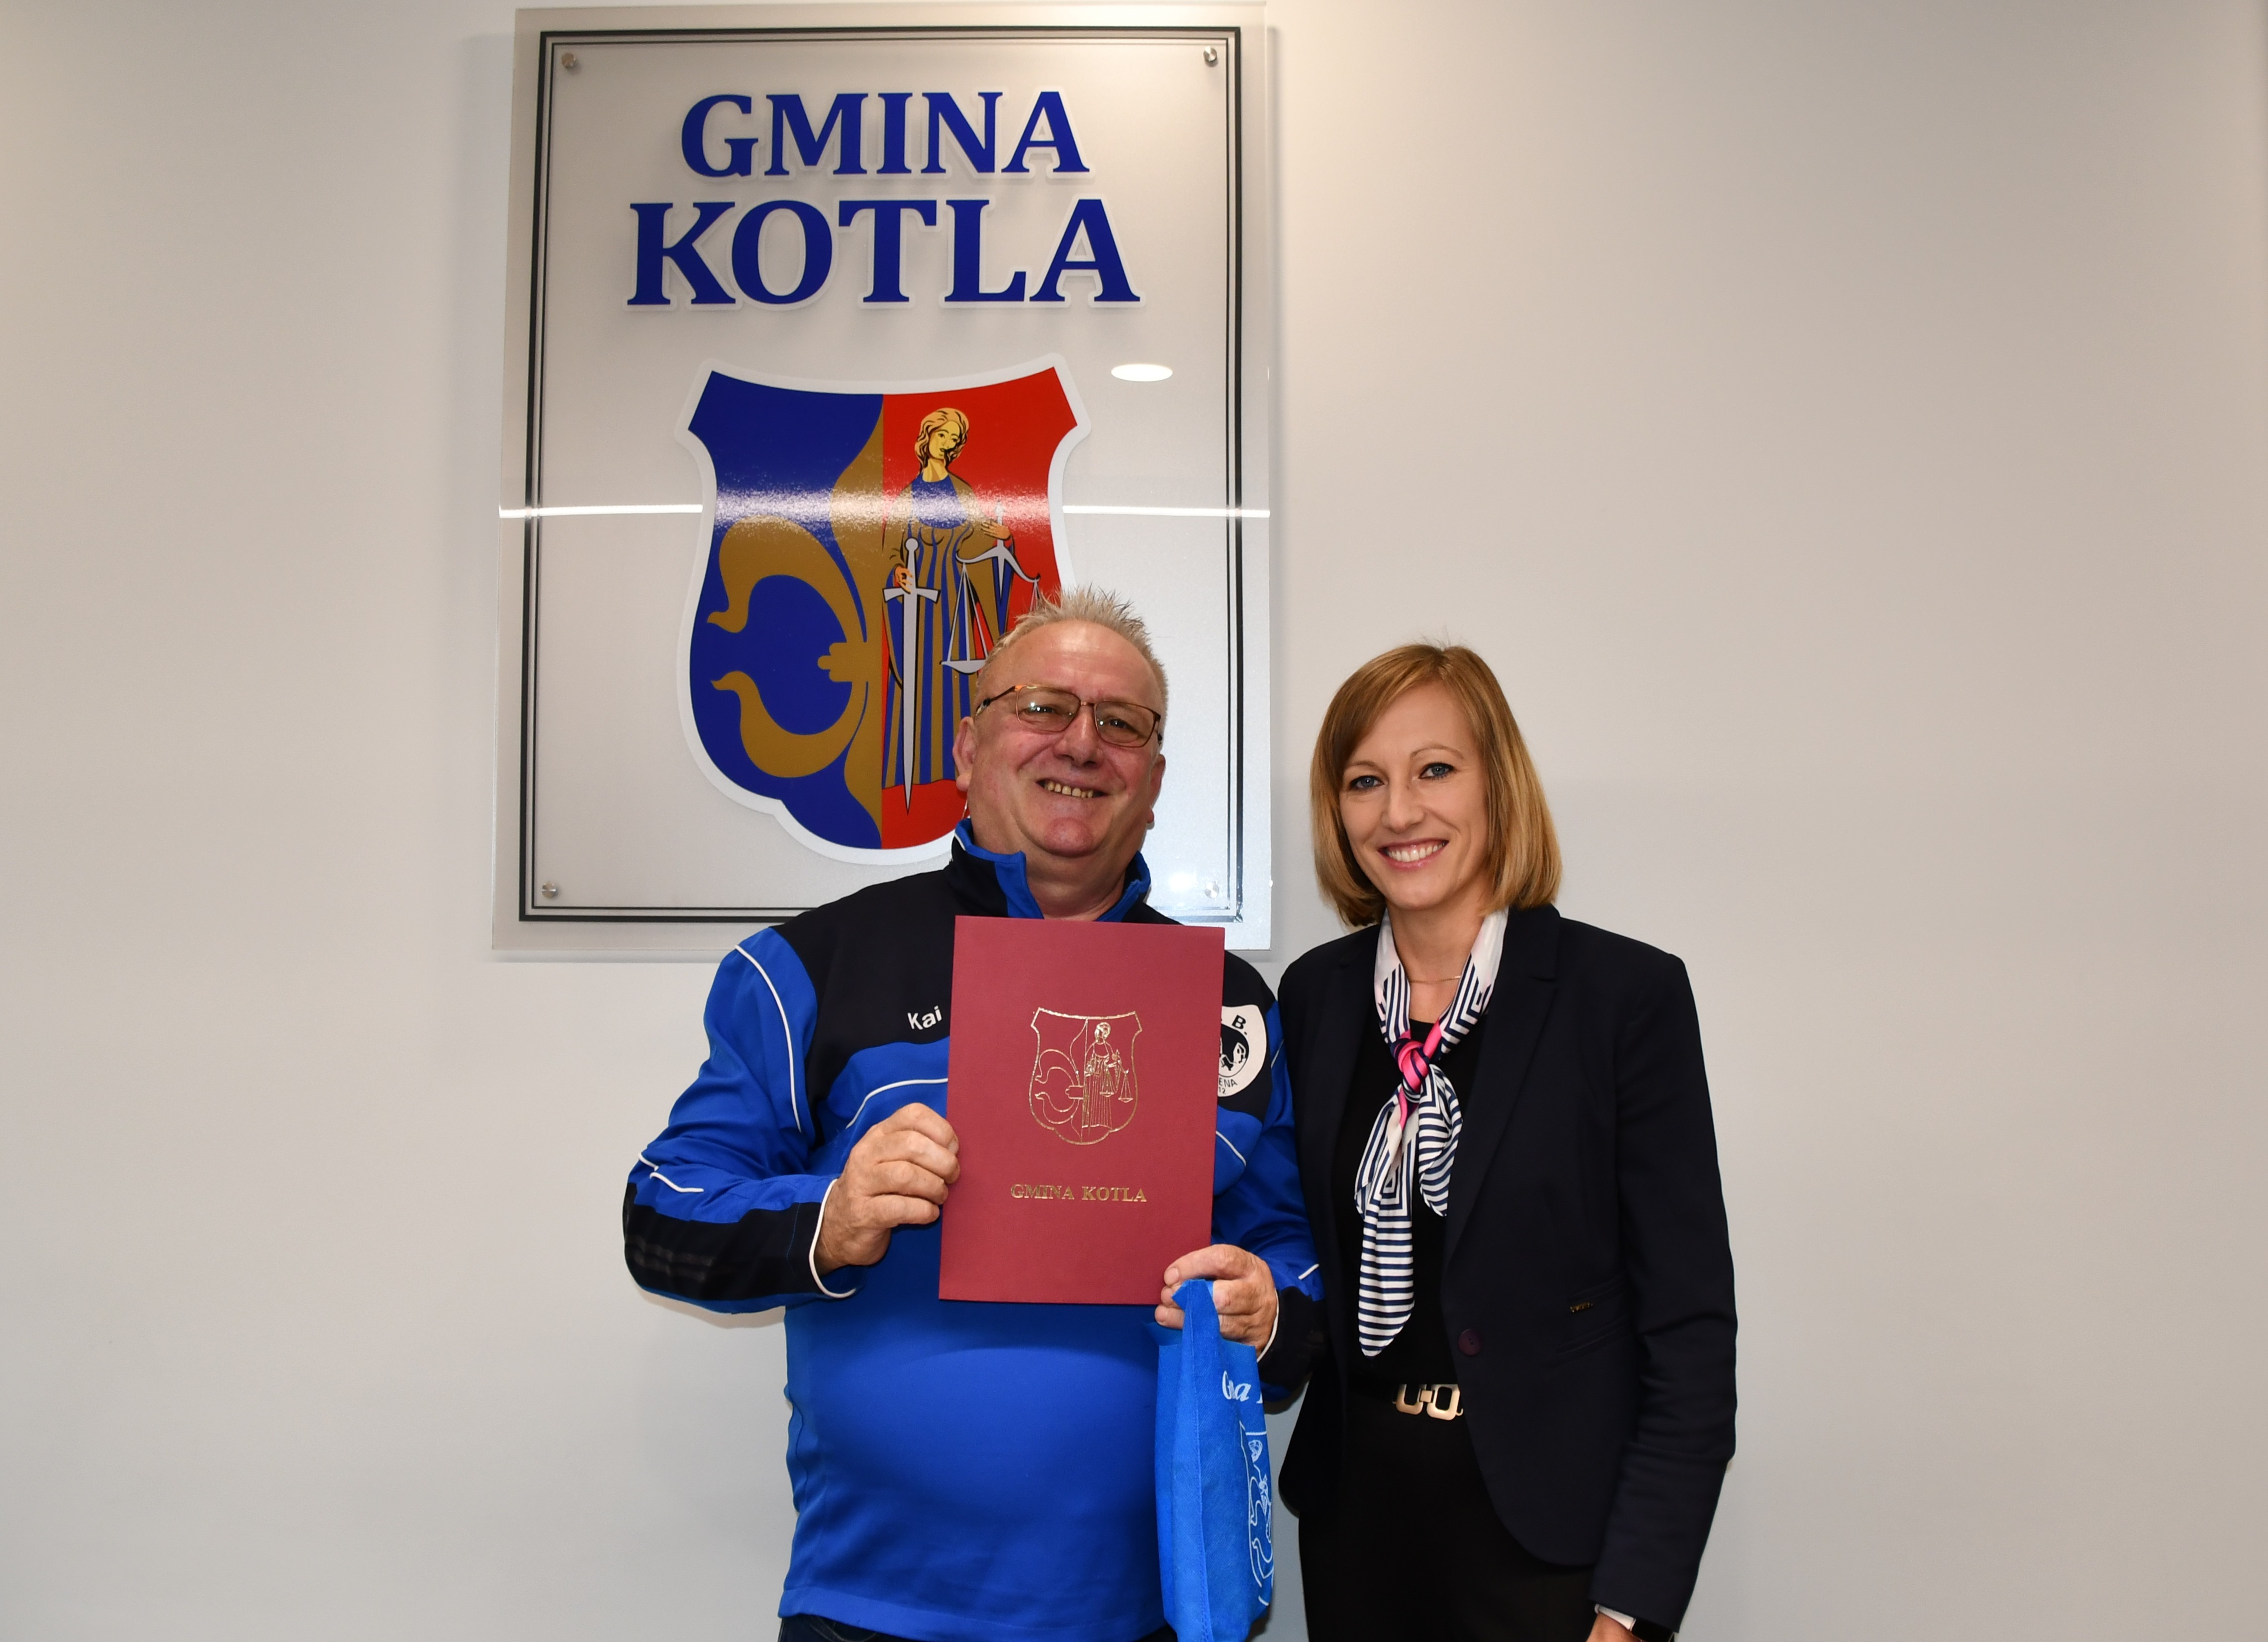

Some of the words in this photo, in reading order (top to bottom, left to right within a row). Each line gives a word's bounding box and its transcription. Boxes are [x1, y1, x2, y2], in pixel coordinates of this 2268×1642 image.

[681, 91, 1090, 177] GMINA
[627, 199, 1140, 305] KOTLA
[907, 1005, 942, 1030] Kai
[1219, 1077, 1238, 1088] ENA
[1010, 1184, 1075, 1200] GMINA
[1081, 1186, 1147, 1202] KOTLA
